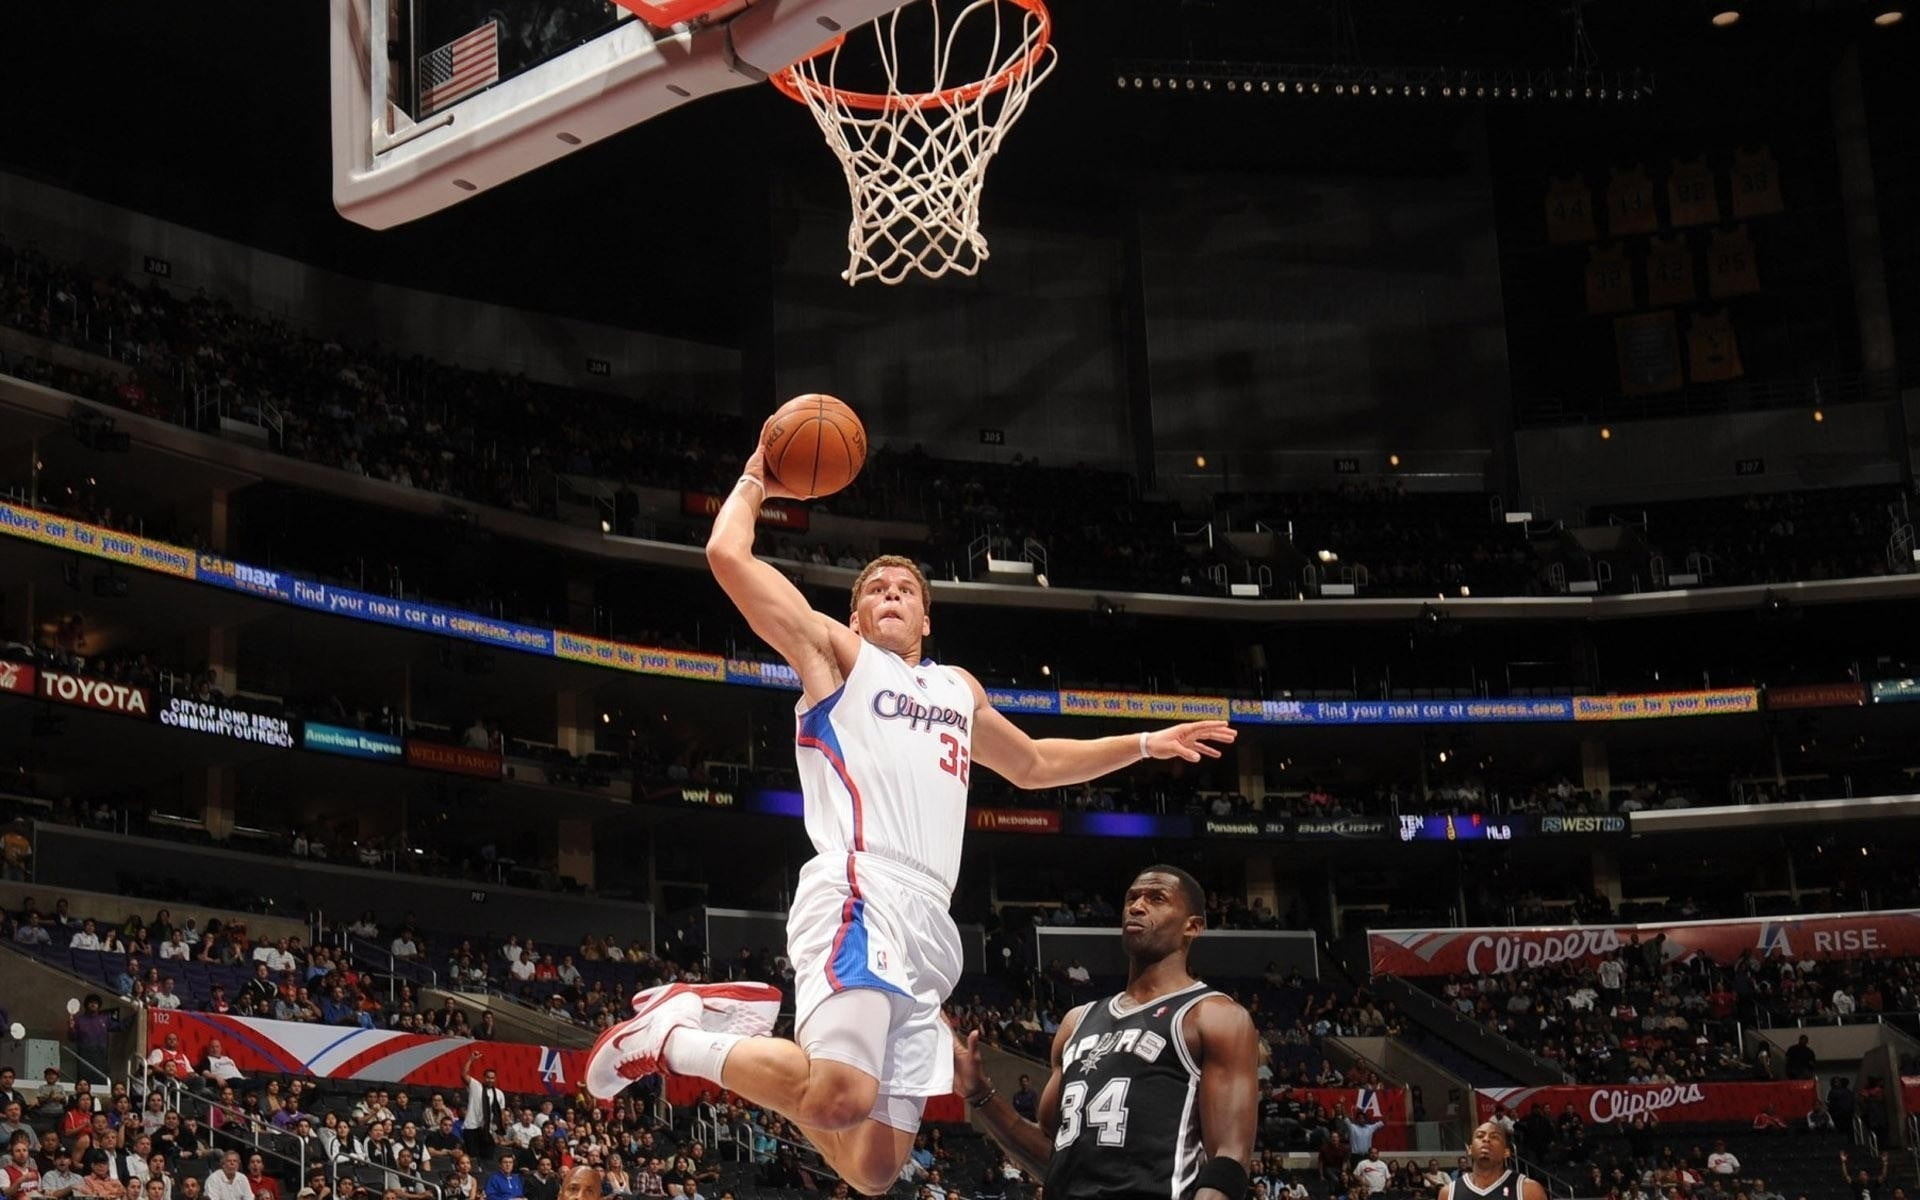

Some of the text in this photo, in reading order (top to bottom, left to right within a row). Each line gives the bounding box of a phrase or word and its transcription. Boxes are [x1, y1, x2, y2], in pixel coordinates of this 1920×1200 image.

[294, 581, 325, 603] Find
[329, 592, 363, 611] your
[368, 600, 400, 619] next
[404, 608, 427, 624] car
[432, 614, 447, 627] at
[41, 671, 146, 714] TOYOTA
[160, 709, 233, 736] COMMUNITY
[170, 698, 199, 716] CITY
[200, 702, 216, 720] OF
[219, 707, 249, 727] LONG
[1318, 702, 1348, 718] Find
[1352, 704, 1383, 721] your
[1388, 703, 1419, 718] next
[1423, 704, 1444, 717] car
[1450, 704, 1463, 717] at
[305, 728, 403, 755] American Express
[409, 746, 499, 771] WELLS FARGO
[682, 787, 733, 805] verion
[998, 815, 1048, 826] McDonald's
[1206, 822, 1258, 834] Panasonic
[1467, 928, 1622, 975] Clippers
[1814, 928, 1887, 952] RISE.
[153, 1012, 170, 1025] 102
[1054, 1077, 1131, 1151] 34
[1589, 1084, 1705, 1123] Clippers
